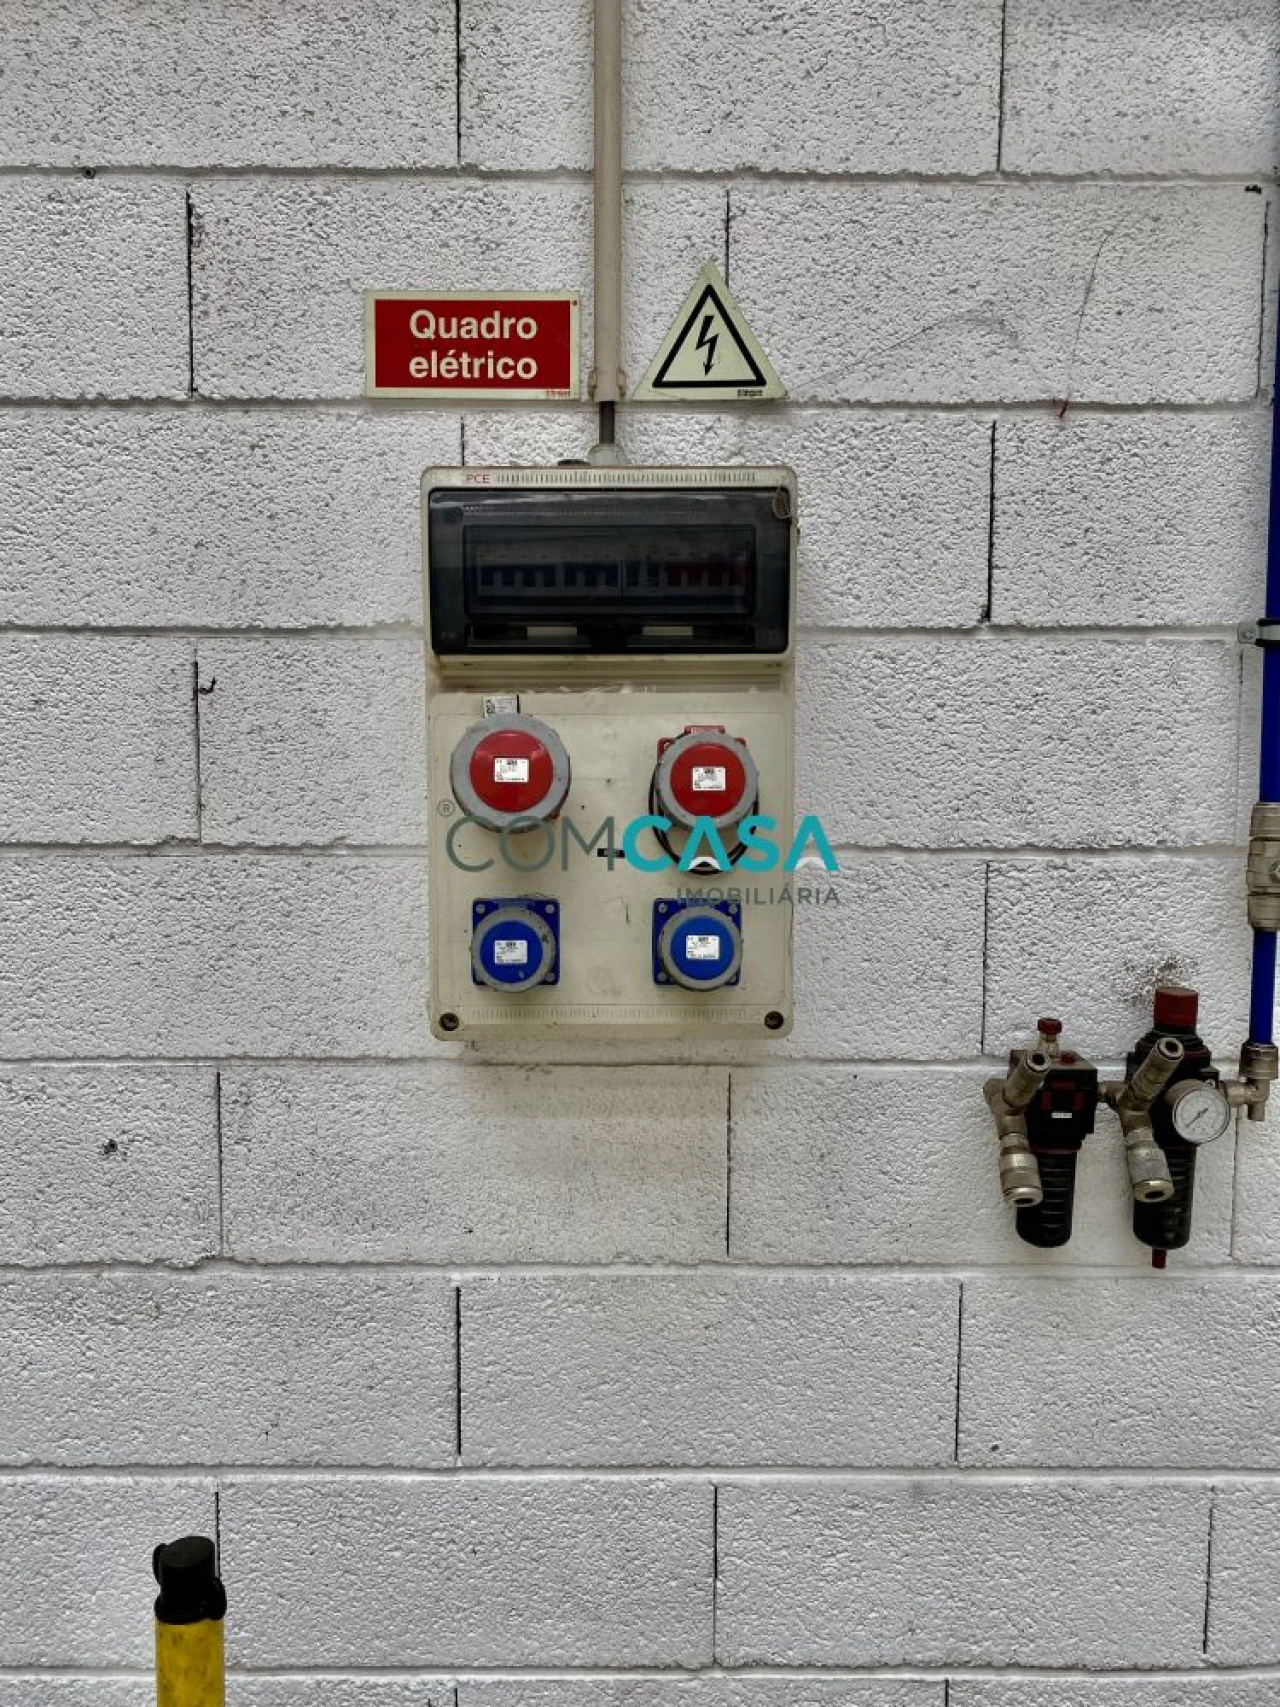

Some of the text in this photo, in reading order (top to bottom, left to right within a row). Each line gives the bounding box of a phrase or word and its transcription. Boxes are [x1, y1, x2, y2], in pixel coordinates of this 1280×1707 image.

[409, 309, 538, 340] Quadro
[408, 349, 538, 380] elétrico
[465, 473, 491, 484] PCE
